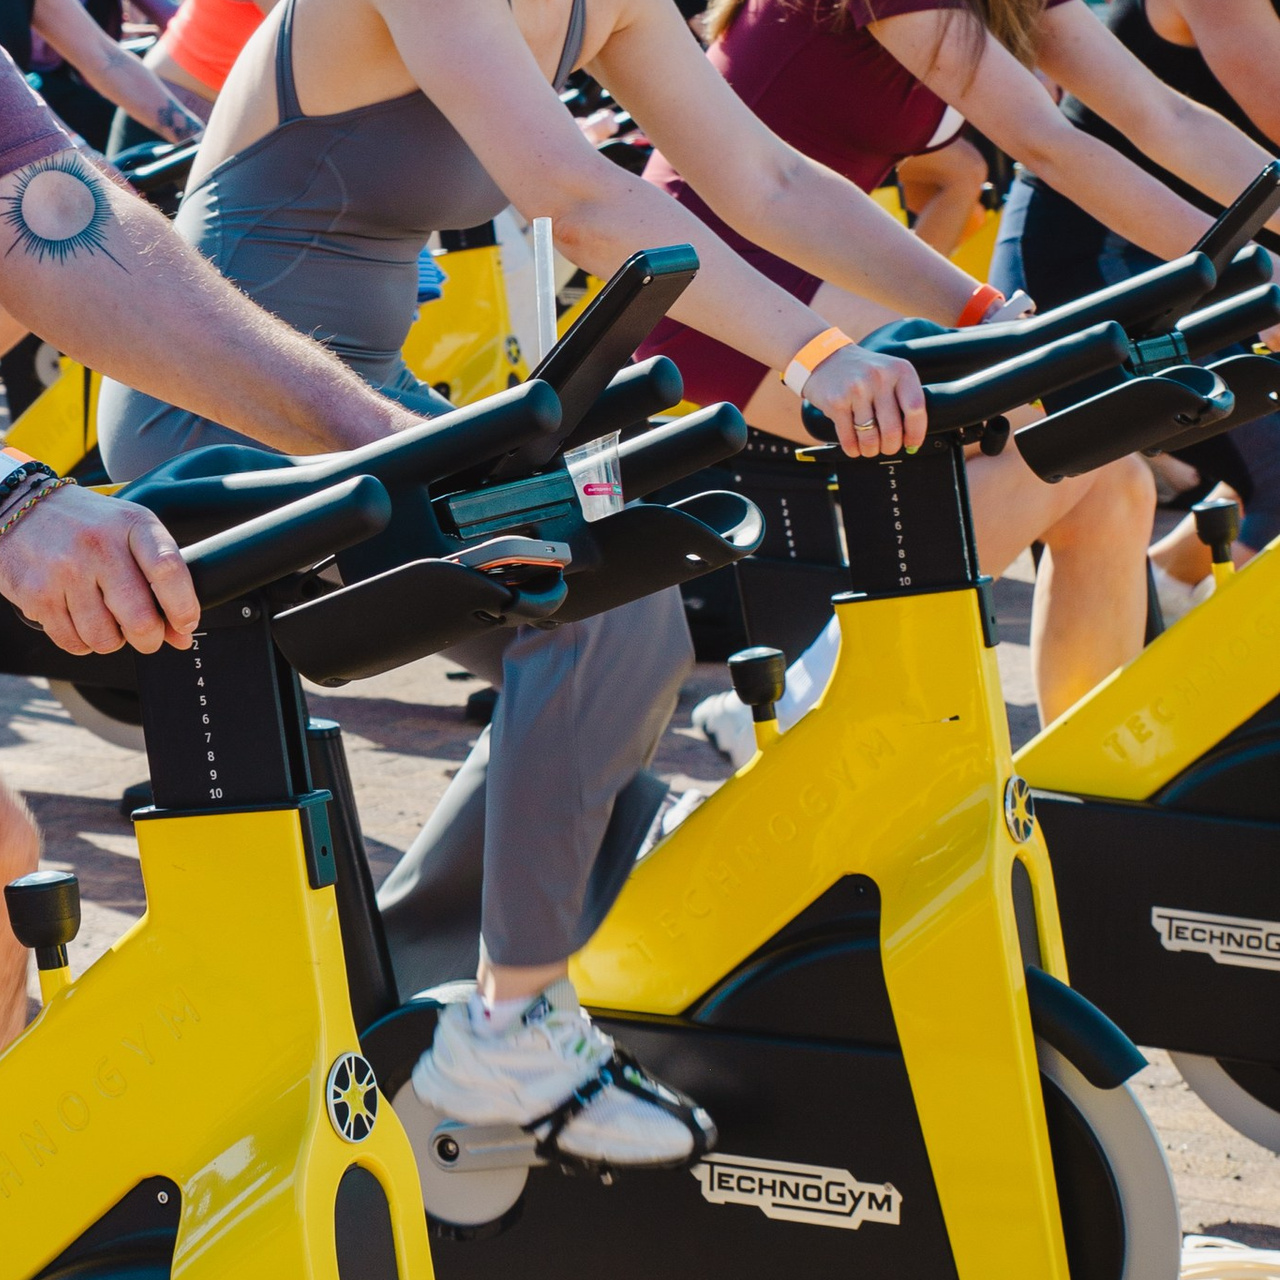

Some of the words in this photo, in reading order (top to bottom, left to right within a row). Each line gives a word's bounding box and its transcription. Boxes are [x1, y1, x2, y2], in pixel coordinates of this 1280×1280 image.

[888, 466, 896, 475] 2
[889, 480, 897, 489] 3
[891, 494, 899, 503] 4
[893, 508, 900, 517] 5
[894, 521, 902, 531] 6
[896, 535, 904, 545] 7
[897, 549, 905, 559] 8
[899, 563, 907, 572] 9
[899, 576, 911, 587] 10
[191, 639, 200, 651] 2
[194, 658, 202, 669] 3
[197, 677, 205, 687] 4
[199, 695, 207, 706] 5
[202, 713, 210, 725] 6
[204, 732, 212, 743] 7
[207, 751, 215, 762] 8
[209, 769, 218, 781] 9
[209, 787, 223, 799] 10
